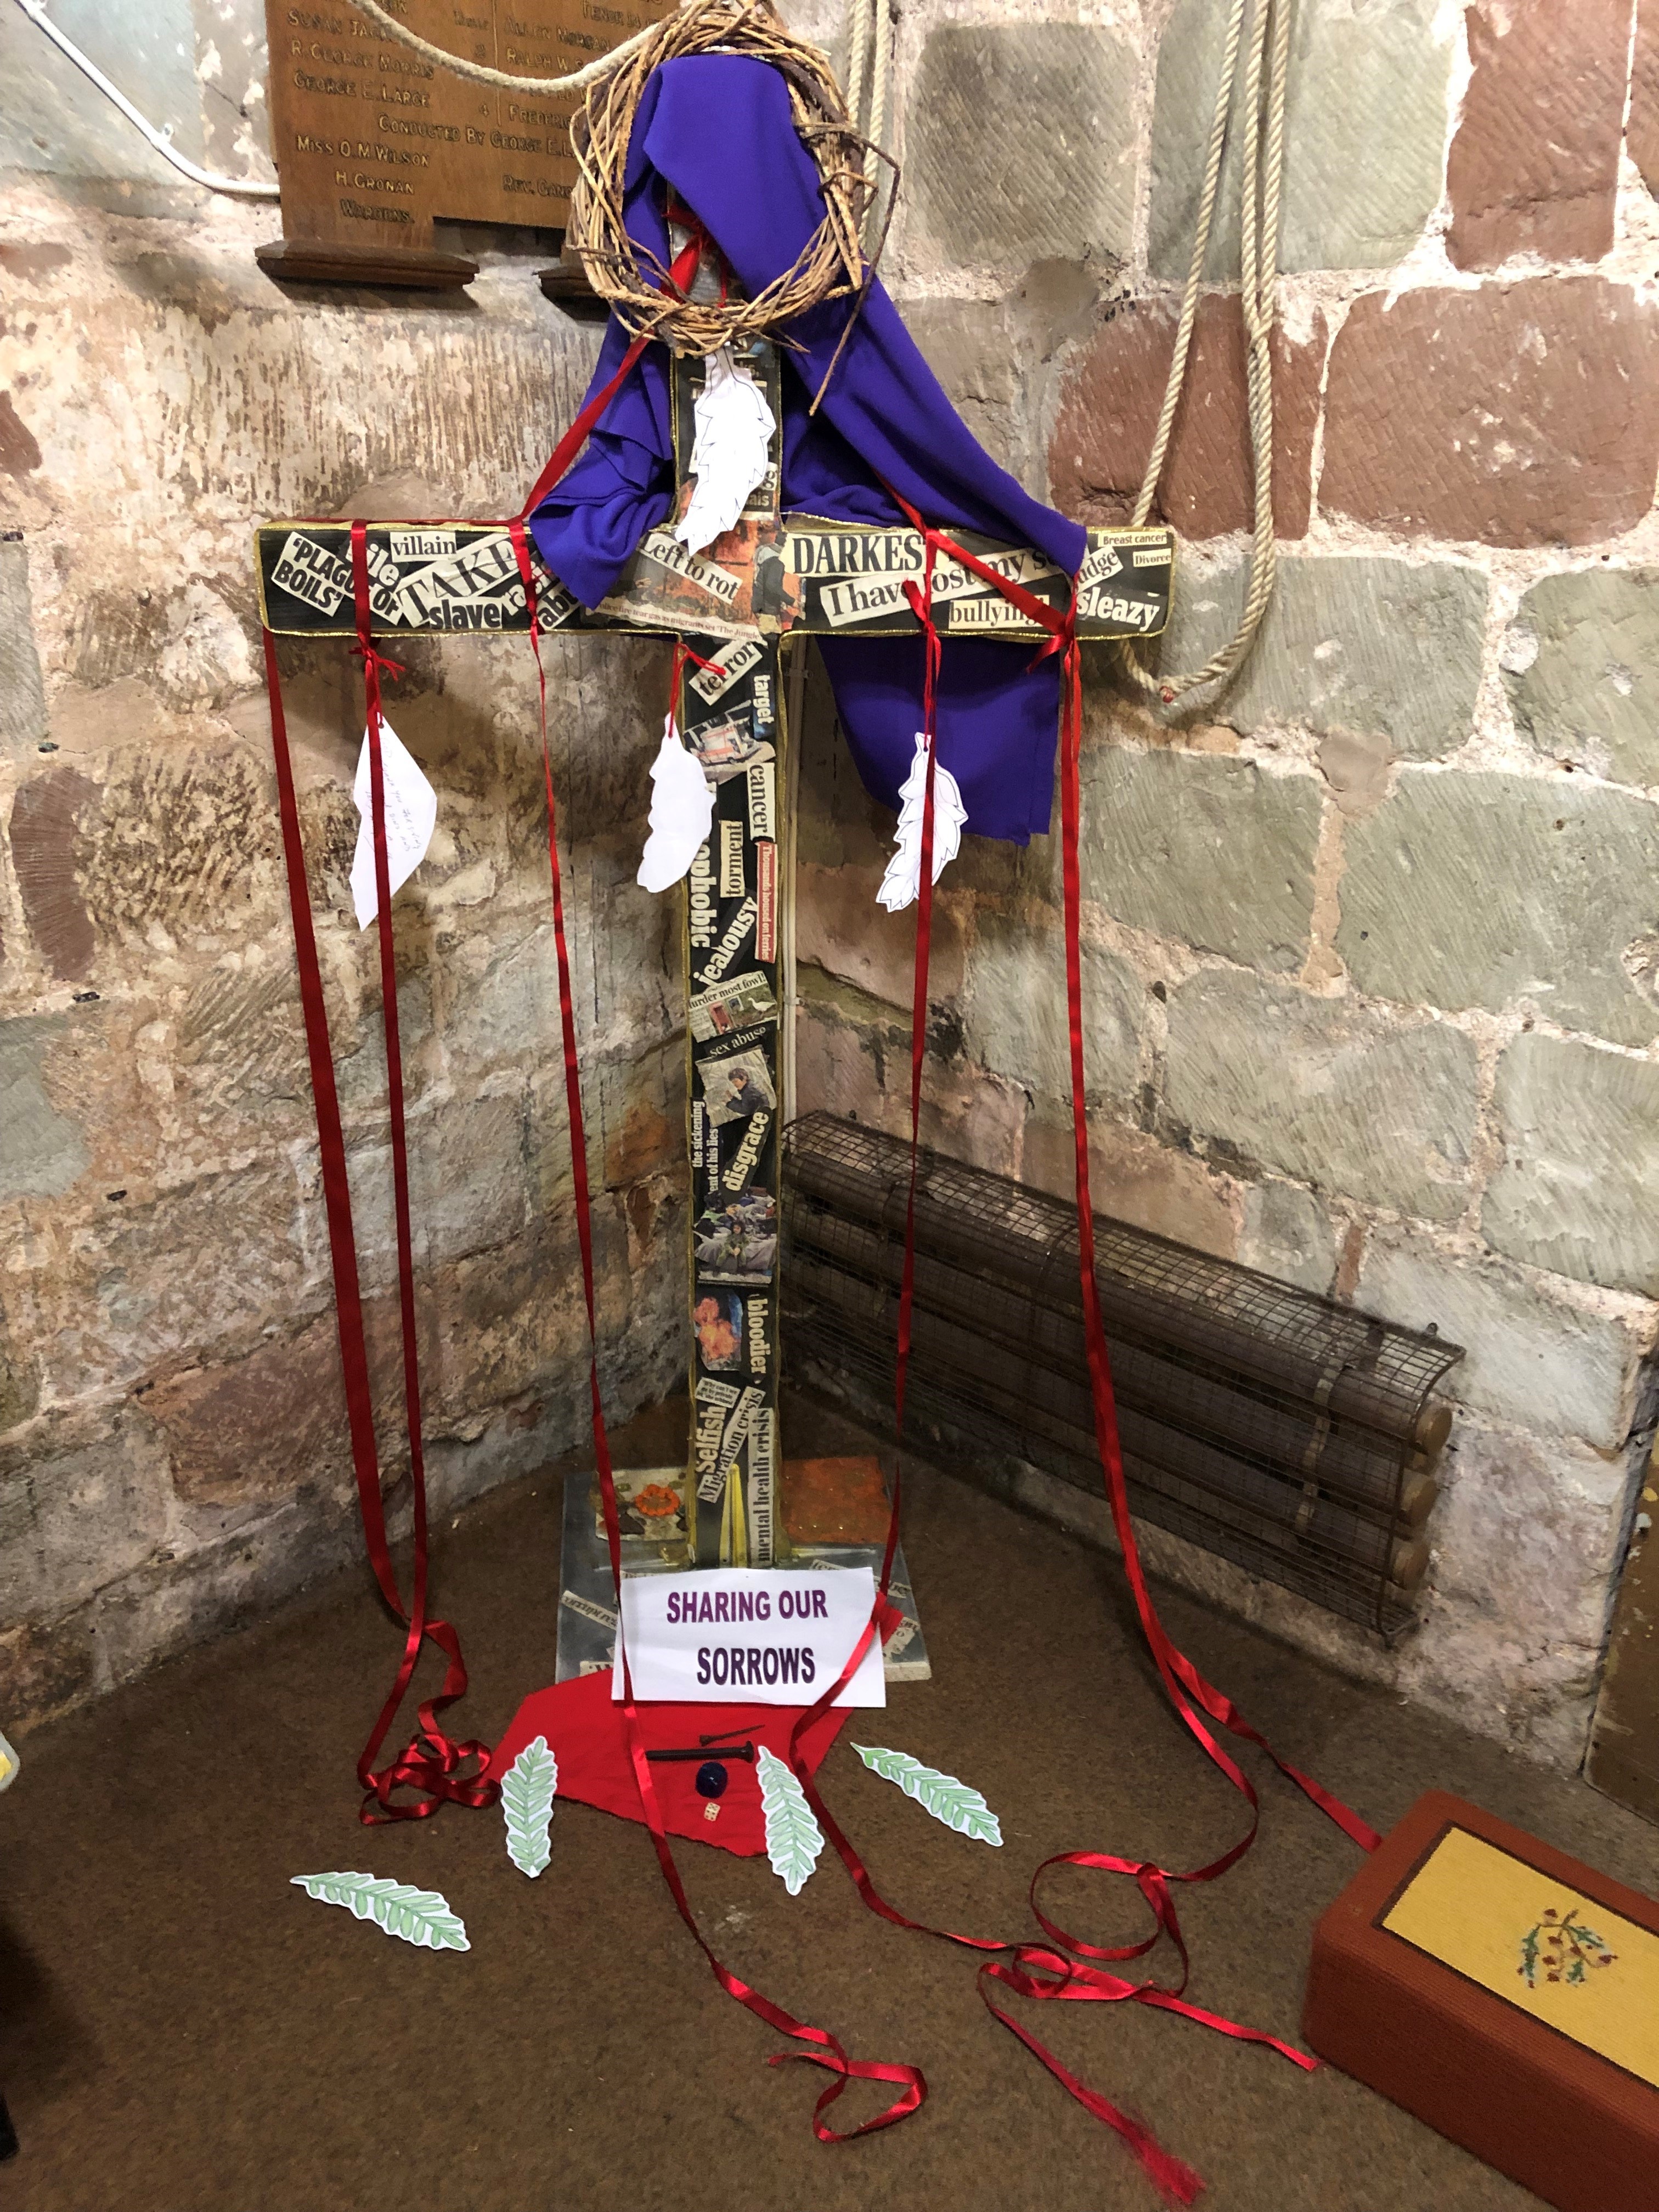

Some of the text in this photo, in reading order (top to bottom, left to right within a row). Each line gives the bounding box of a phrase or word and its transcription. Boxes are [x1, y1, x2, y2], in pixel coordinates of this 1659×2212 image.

[506, 45, 551, 69] RALPH
[294, 69, 357, 97] GEORGE
[297, 134, 334, 155] MISS
[375, 145, 430, 168] WILSON
[379, 113, 461, 142] CONDUCTED
[465, 126, 486, 146] BY
[490, 132, 543, 154] GEORGE
[392, 535, 457, 556] villain
[792, 534, 936, 575] DARKES
[1103, 534, 1167, 545] Breast cancer
[1135, 554, 1171, 565] Divorce
[640, 533, 739, 600] Left to rot
[429, 599, 501, 630] slave
[827, 586, 844, 617] I
[1076, 586, 1160, 632] sleazy
[753, 675, 775, 724] target
[749, 764, 768, 833] cancer
[726, 825, 741, 896] torment
[693, 896, 758, 987] jealousy
[720, 985, 741, 998] most
[742, 974, 766, 991] fowl!
[709, 1026, 766, 1058] sex abuse
[691, 1101, 705, 1168] the sickening
[722, 1111, 769, 1192] disgrace
[706, 1128, 719, 1195] ent of his lies
[747, 1298, 771, 1374] bloodier
[695, 1406, 727, 1473] Selfish
[699, 1431, 743, 1500] Migration
[737, 1391, 763, 1430] crisis
[752, 1409, 770, 1561] mental health crisis
[667, 1589, 828, 1624] SHARING OUR
[697, 1647, 815, 1685] SORROWS
